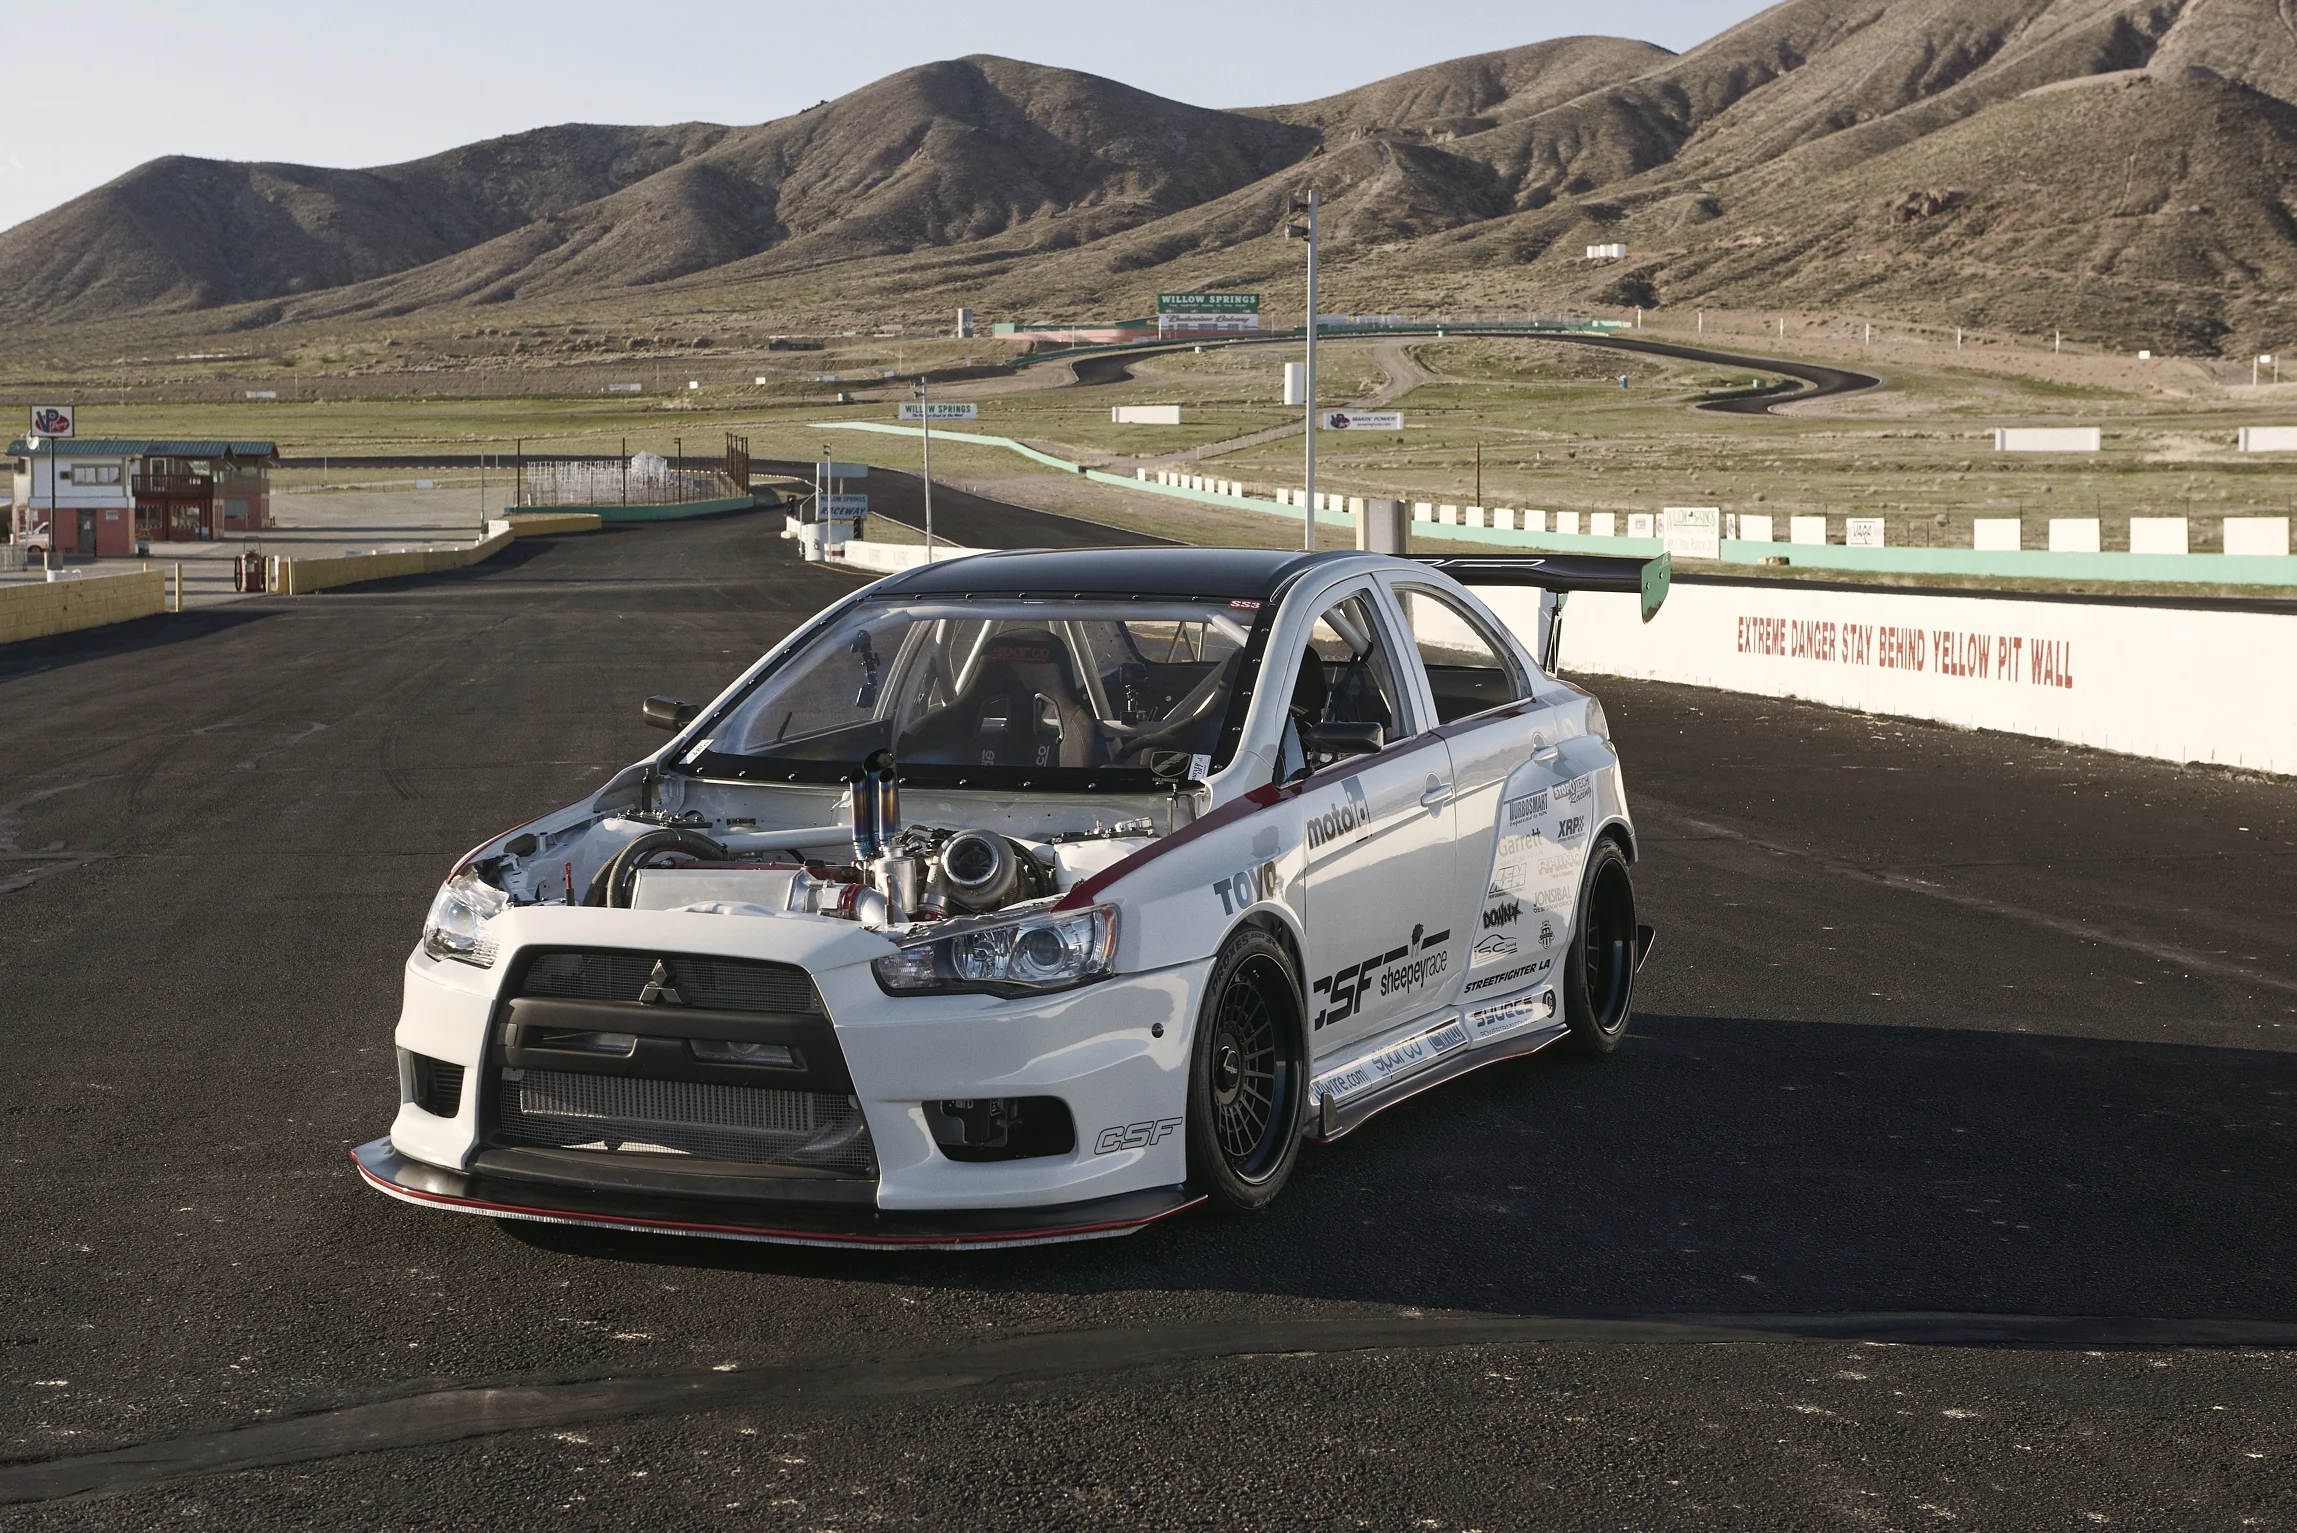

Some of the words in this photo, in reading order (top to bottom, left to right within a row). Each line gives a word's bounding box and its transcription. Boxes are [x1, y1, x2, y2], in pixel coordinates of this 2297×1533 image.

[1161, 295, 1205, 304] WILLOW
[1209, 295, 1256, 304] SPRINGS
[36, 408, 59, 433] VP
[905, 405, 935, 413] WILLW
[938, 405, 971, 413] SPRINGS
[1737, 616, 1786, 657] EXTREME
[1790, 619, 1836, 662] DANGER
[1841, 623, 1873, 666] STAY
[1878, 626, 1926, 673] BEHIND
[1933, 631, 1991, 680] YELLOW
[1998, 635, 2023, 683] PIT
[2031, 638, 2074, 689] WALL
[1504, 787, 1548, 821] TURBOSMART
[1498, 827, 1543, 857] Garrett
[1557, 818, 1580, 839] XRP
[1537, 852, 1582, 875] RHINO
[1212, 860, 1277, 917] TOYO
[1532, 884, 1573, 908] JONSIBAL
[1380, 950, 1448, 997] sheepeyrace
[1463, 962, 1538, 994] STREETFIGHTER
[1538, 958, 1551, 971] LA
[1093, 1116, 1184, 1156] CSF
